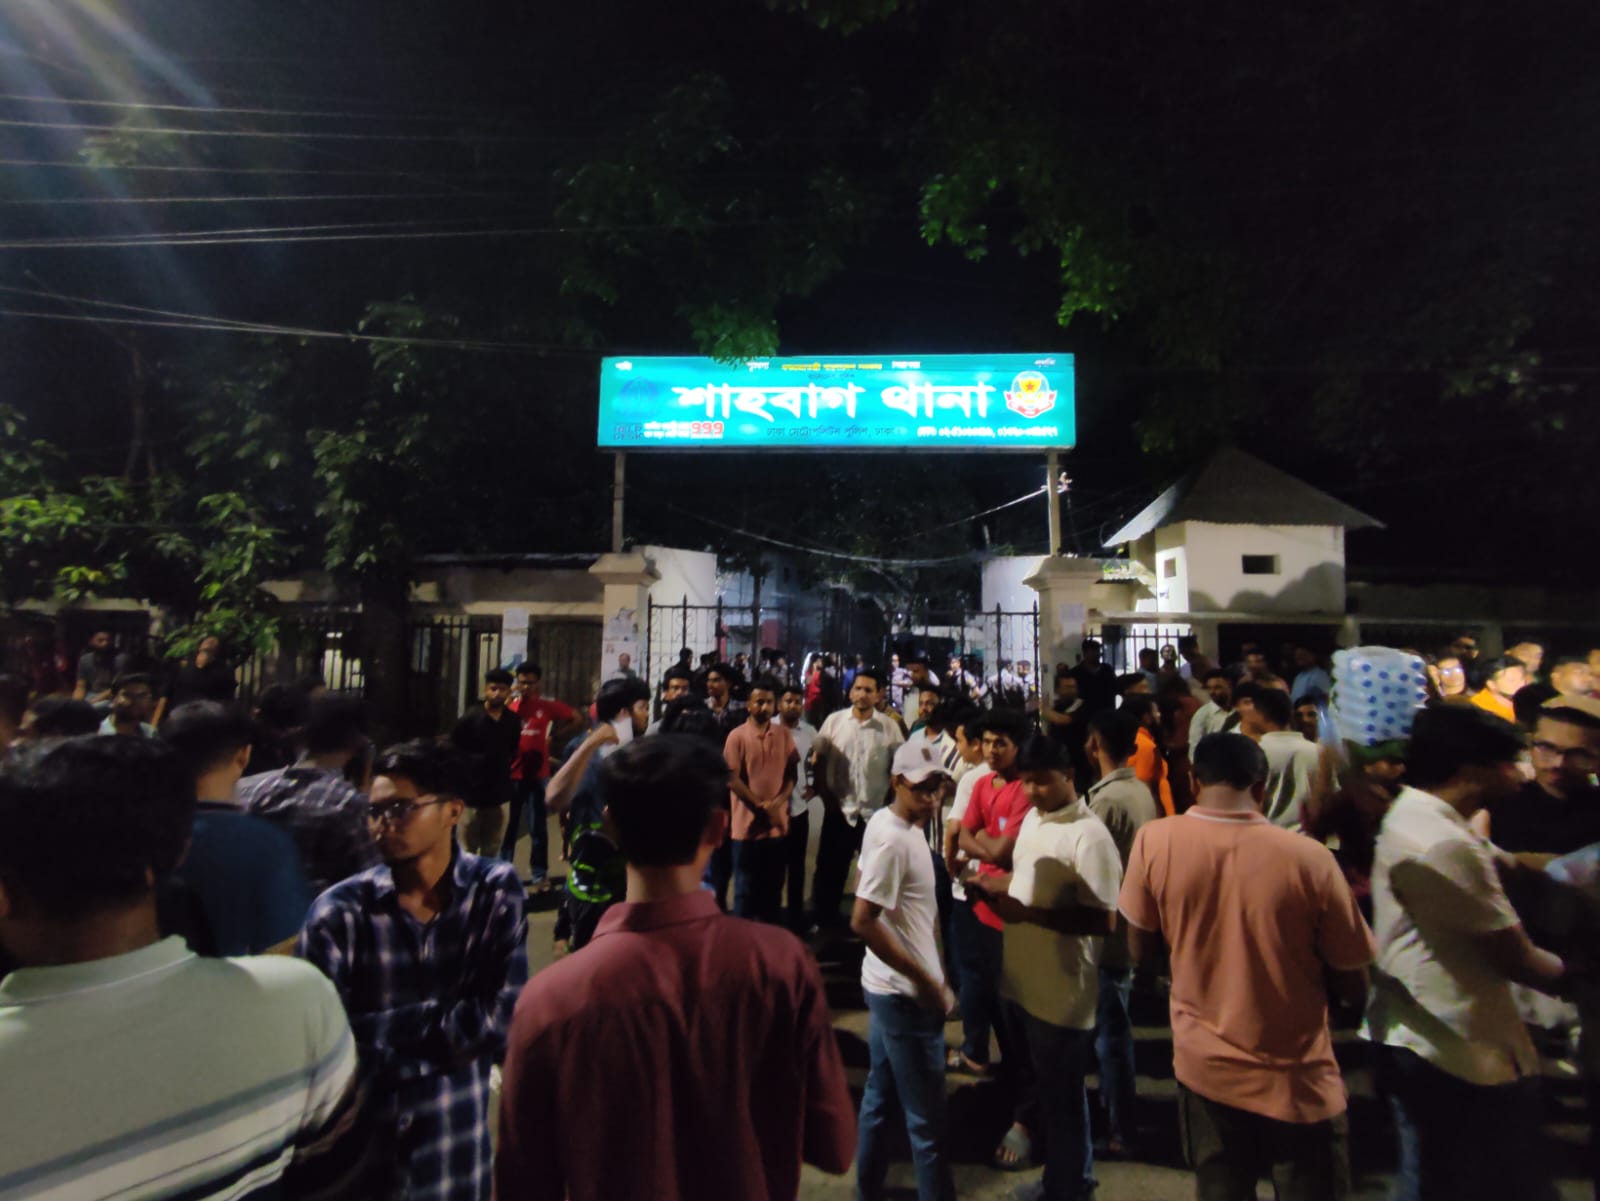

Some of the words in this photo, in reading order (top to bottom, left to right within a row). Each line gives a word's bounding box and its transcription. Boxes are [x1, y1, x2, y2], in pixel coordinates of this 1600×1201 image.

[671, 382, 866, 422] শাহবাগ
[881, 381, 997, 418] থানা
[691, 422, 724, 434] 999
